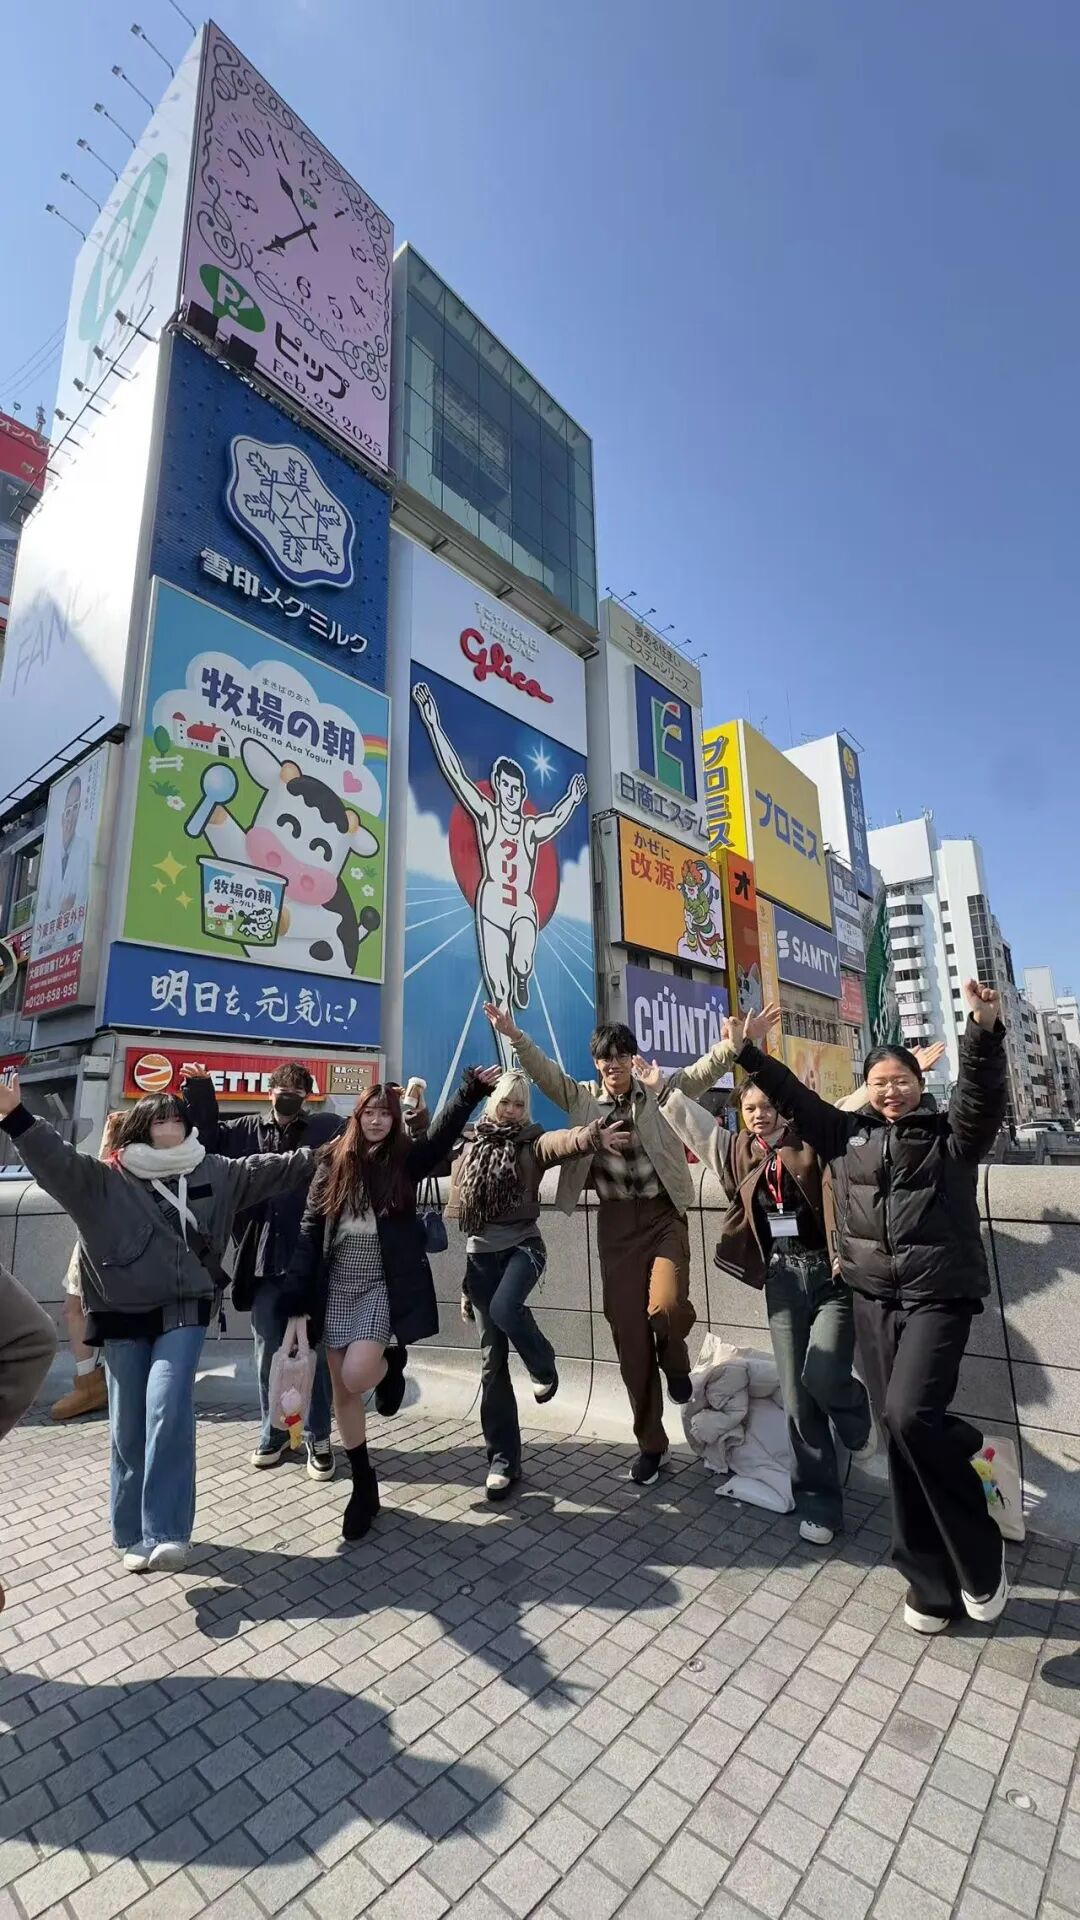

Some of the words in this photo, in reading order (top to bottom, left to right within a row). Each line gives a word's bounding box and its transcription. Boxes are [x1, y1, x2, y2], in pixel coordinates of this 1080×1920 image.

[237, 127, 265, 159] 10
[267, 133, 290, 166] 11
[227, 148, 250, 177] 9
[299, 159, 321, 194] 12
[235, 190, 259, 214] 8
[296, 276, 311, 299] 6
[327, 295, 343, 320] 5
[350, 295, 366, 319] 4
[275, 321, 351, 399] ピップ
[201, 546, 369, 654] 雪印メグミルク
[459, 627, 554, 704] Glico
[201, 667, 355, 766] 牧場の朝
[230, 718, 268, 741] Makiba
[271, 735, 283, 746] no
[285, 740, 303, 754] Asa
[303, 746, 333, 766] Yogurt
[703, 735, 736, 852] プロミス
[755, 788, 821, 866] プロミス
[634, 831, 671, 861] かぜに
[500, 838, 519, 907] グリコ
[630, 850, 676, 891] 改源
[213, 878, 272, 905] 牧場の朝
[230, 898, 256, 909] ヨーグルト
[792, 935, 838, 977] SAMTY
